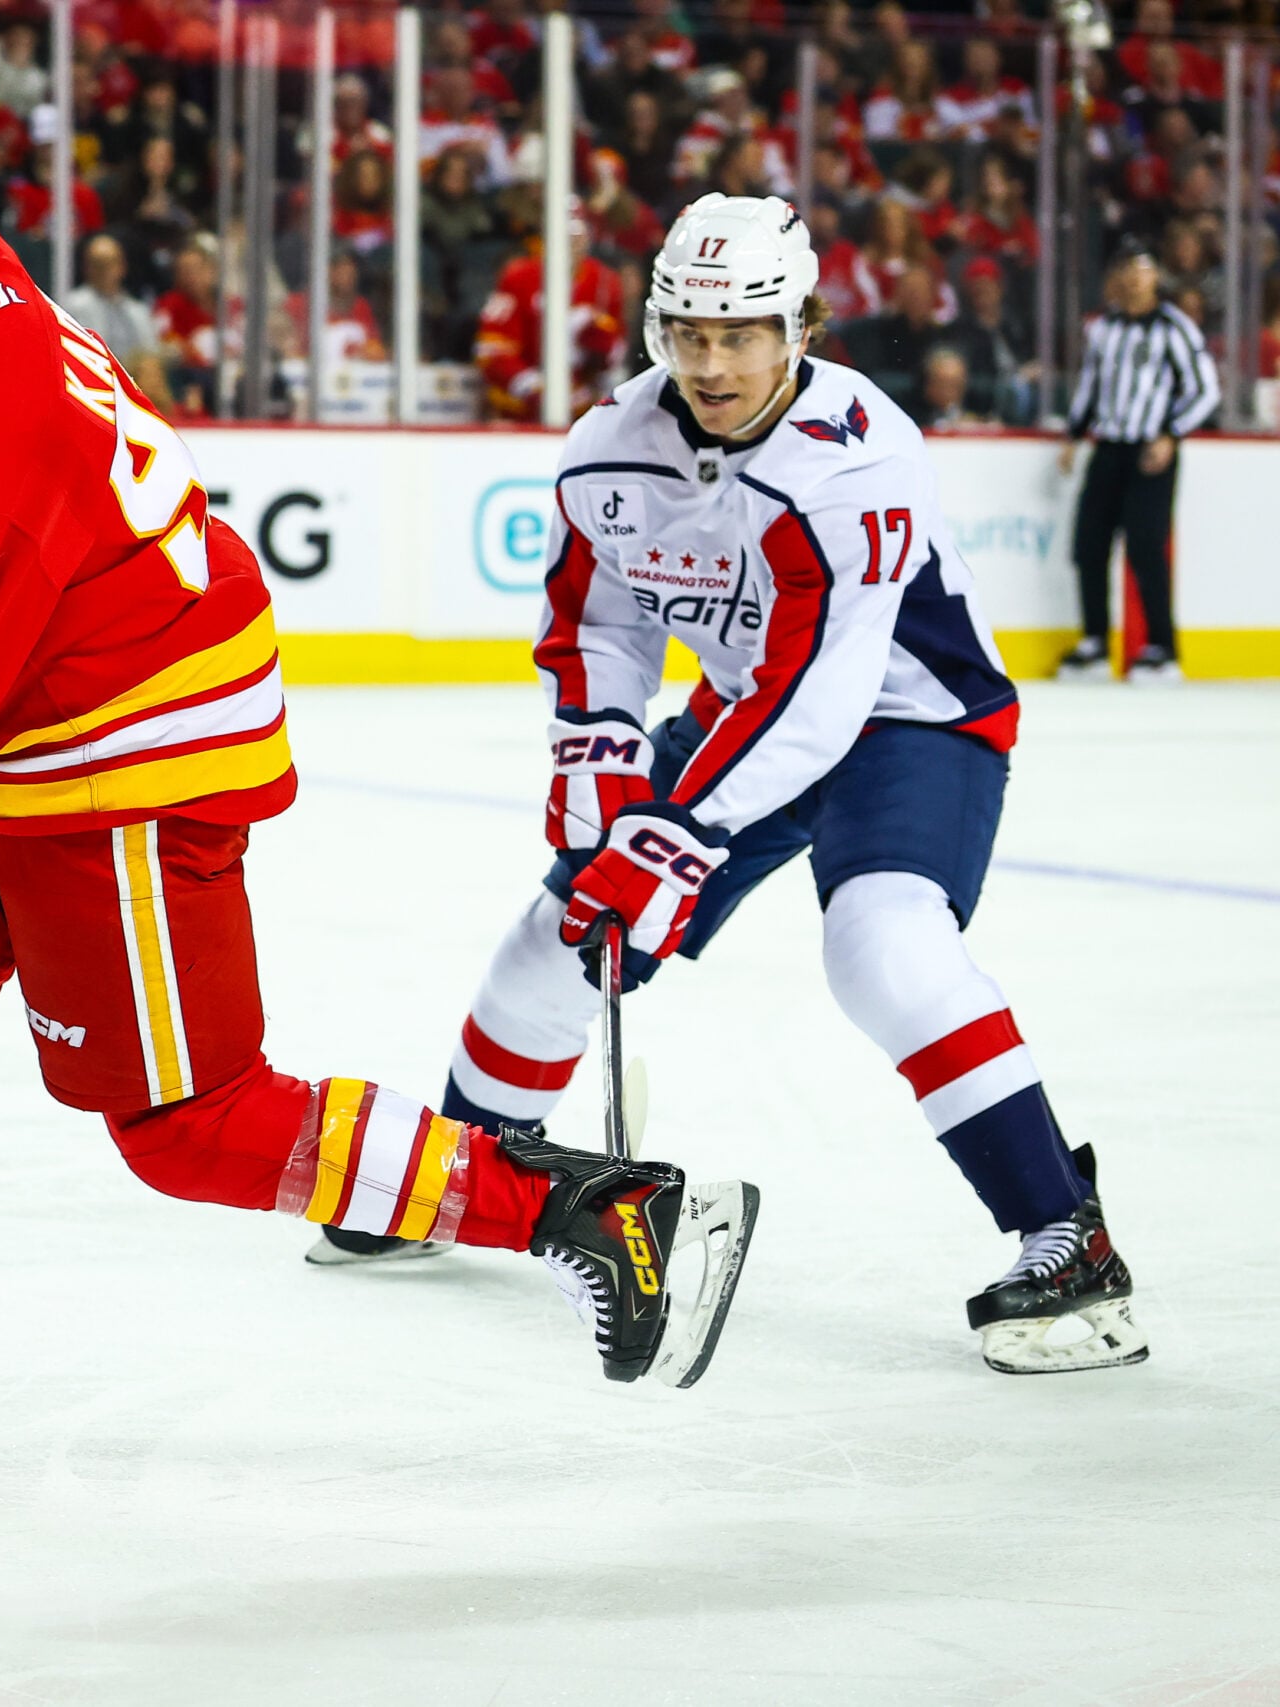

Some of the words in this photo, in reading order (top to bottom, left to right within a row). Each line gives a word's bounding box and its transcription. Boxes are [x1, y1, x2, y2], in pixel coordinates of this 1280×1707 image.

[698, 237, 728, 259] 17
[685, 277, 731, 289] CCM
[50, 298, 117, 426] KA
[600, 523, 638, 536] kTok
[860, 507, 913, 586] 17
[627, 567, 731, 589] WASHINGTON
[631, 544, 762, 648] apita
[551, 736, 642, 766] CM
[628, 827, 713, 888] CC
[614, 1201, 660, 1296] CCM
